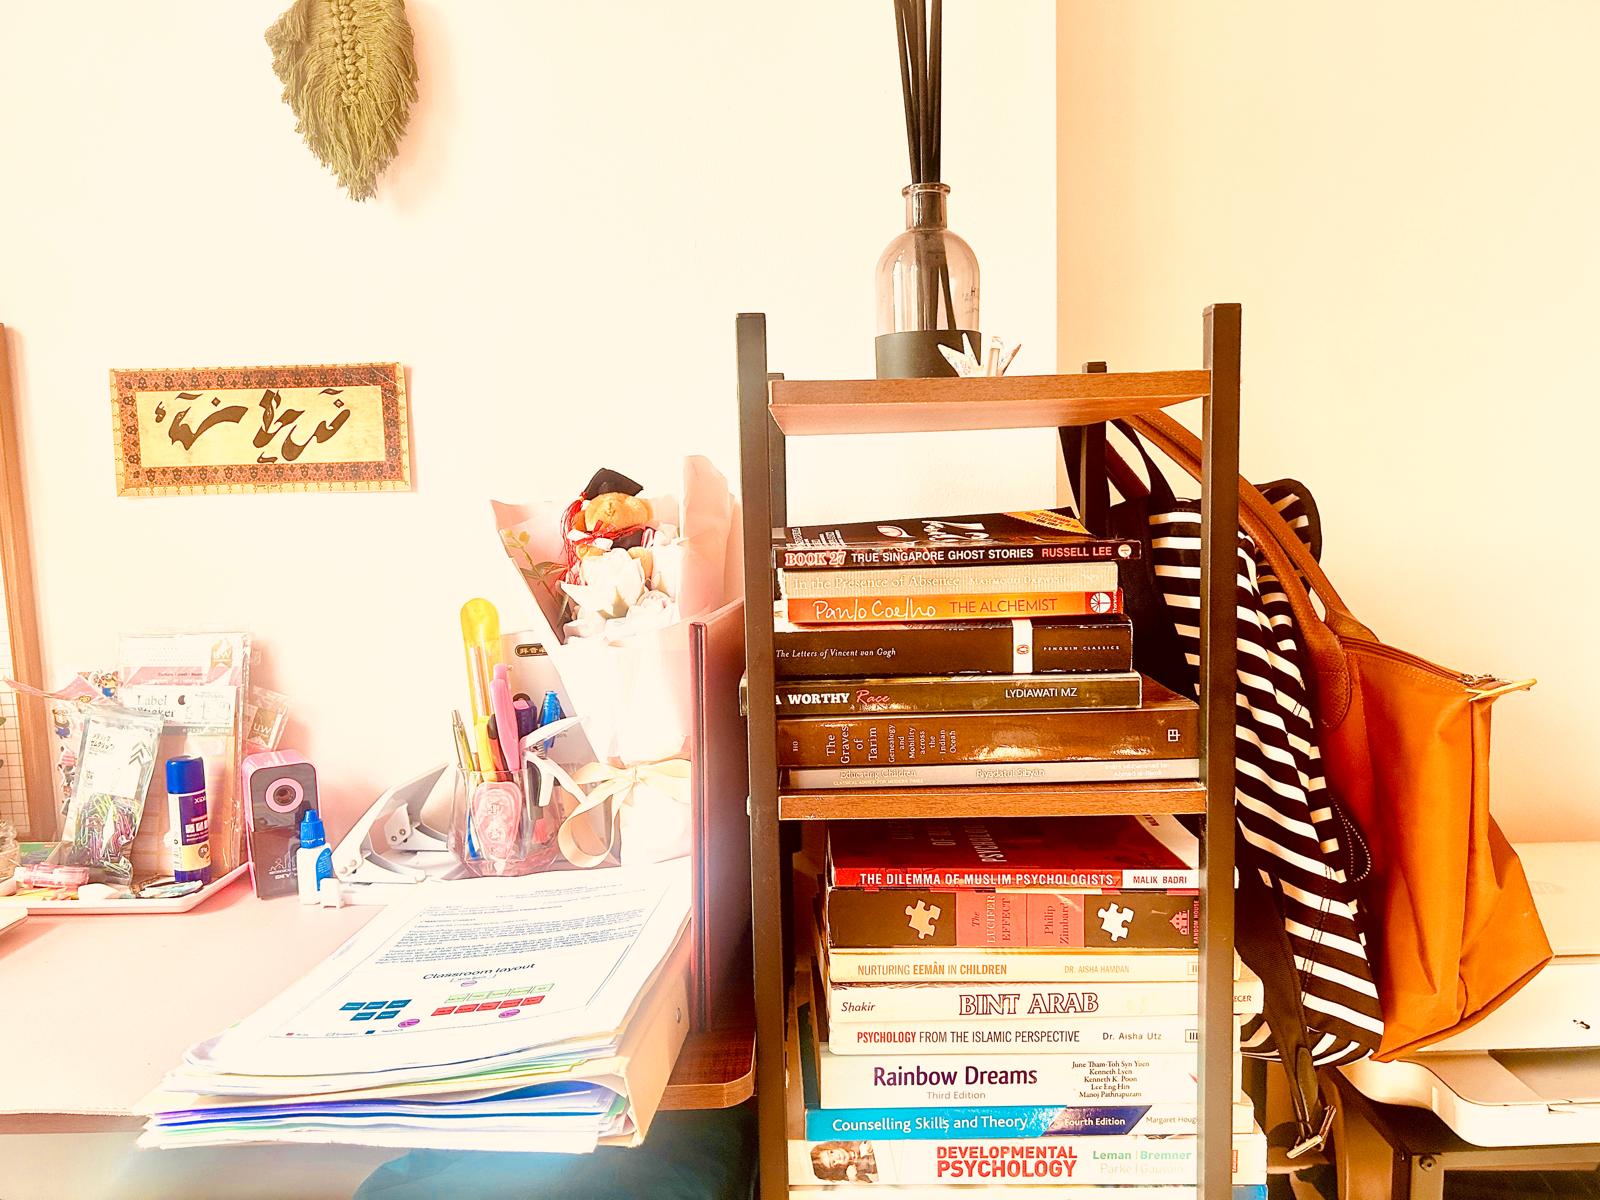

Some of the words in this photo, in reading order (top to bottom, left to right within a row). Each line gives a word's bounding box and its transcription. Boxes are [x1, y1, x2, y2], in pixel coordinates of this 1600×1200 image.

[785, 552, 827, 566] BOOK
[830, 551, 847, 565] 27
[851, 552, 879, 563] TRUE
[882, 551, 945, 562] SINGAPORE
[948, 550, 985, 560] GHOST
[989, 548, 1034, 559] STORIES
[1042, 547, 1089, 557] RUSSELL
[1093, 546, 1112, 556] LEE
[794, 578, 808, 590] In
[811, 578, 831, 589] the
[834, 576, 888, 589] Presence
[891, 575, 905, 587] of
[909, 575, 960, 587] Absence
[871, 597, 936, 618] Coelho
[950, 602, 976, 613] THE
[980, 599, 1058, 613] ALCHEMIST
[776, 650, 789, 658] The
[792, 650, 817, 658] Letters
[819, 649, 829, 659] of
[830, 649, 858, 657] Vincent
[860, 649, 874, 657] van
[876, 648, 896, 658] Gogh
[788, 692, 850, 705] WORTHY
[856, 689, 891, 705] Race
[1005, 688, 1058, 698] LYDIAWATI
[1060, 687, 1078, 697] MZ
[137, 695, 168, 706] Label
[826, 734, 836, 757] The
[840, 725, 850, 764] Graves
[854, 738, 864, 750] of
[868, 727, 878, 761] Tarim
[888, 724, 897, 763] Genealogy
[909, 727, 917, 759] Mobility
[881, 768, 917, 778] Children
[860, 873, 882, 885] THE
[886, 873, 941, 885] DILEMMA
[944, 873, 959, 885] OF
[965, 873, 1012, 885] MUSLIM
[1015, 873, 1114, 885] PSYCHOLOGISTS
[1132, 875, 1158, 884] MALIK
[1162, 875, 1187, 884] BADRI
[971, 912, 980, 927] The
[986, 895, 996, 943] LUCIFER
[1002, 897, 1011, 941] EFFECT
[1044, 905, 1055, 935] Philip
[422, 969, 493, 981] Classroom
[496, 962, 536, 974] layout
[857, 965, 910, 976] NURTURING
[913, 961, 945, 975] EEMÂN
[948, 964, 957, 975] IN
[960, 964, 1007, 975] CHILDREN
[1064, 965, 1075, 973] DR.
[1078, 965, 1098, 973] AISHA
[1100, 965, 1130, 973] HAMDAN
[840, 1001, 876, 1013] Shakir
[959, 994, 1021, 1015] BINT
[1027, 993, 1099, 1014] ARAB
[857, 1031, 917, 1043] PSYCHOLOGY
[919, 1031, 947, 1043] FROM
[950, 1031, 969, 1042] THE
[972, 1031, 1012, 1042] ISLAMIC
[1014, 1031, 1080, 1042] PERSPECTIVE
[1102, 1032, 1115, 1040] Dr.
[1118, 1032, 1144, 1040] Aisha
[1146, 1032, 1162, 1040] Utz
[1072, 1060, 1086, 1069] June
[1087, 1060, 1120, 1068] Tham-Toh
[1121, 1060, 1133, 1069] Syn
[874, 1066, 958, 1086] Rainbow
[965, 1066, 1038, 1085] Dreams
[1104, 1083, 1117, 1091] Eng
[927, 1091, 950, 1099] Third
[953, 1091, 986, 1099] Edition
[1079, 1091, 1100, 1099] Manoj
[1100, 1091, 1142, 1099] Pathnapuram
[832, 1118, 912, 1133] Counselling
[915, 1116, 949, 1130] Skills
[953, 1116, 978, 1129] and
[981, 1116, 1028, 1131] Theory
[1064, 1117, 1093, 1126] Fourth
[1095, 1117, 1126, 1126] Edition
[1146, 1116, 1176, 1125] Margaret
[937, 1146, 1078, 1159] DEVELOPMENTAL
[1093, 1150, 1132, 1160] Leman
[1140, 1150, 1192, 1160] Bremner
[937, 1160, 1077, 1177] PSYCHOLOGY
